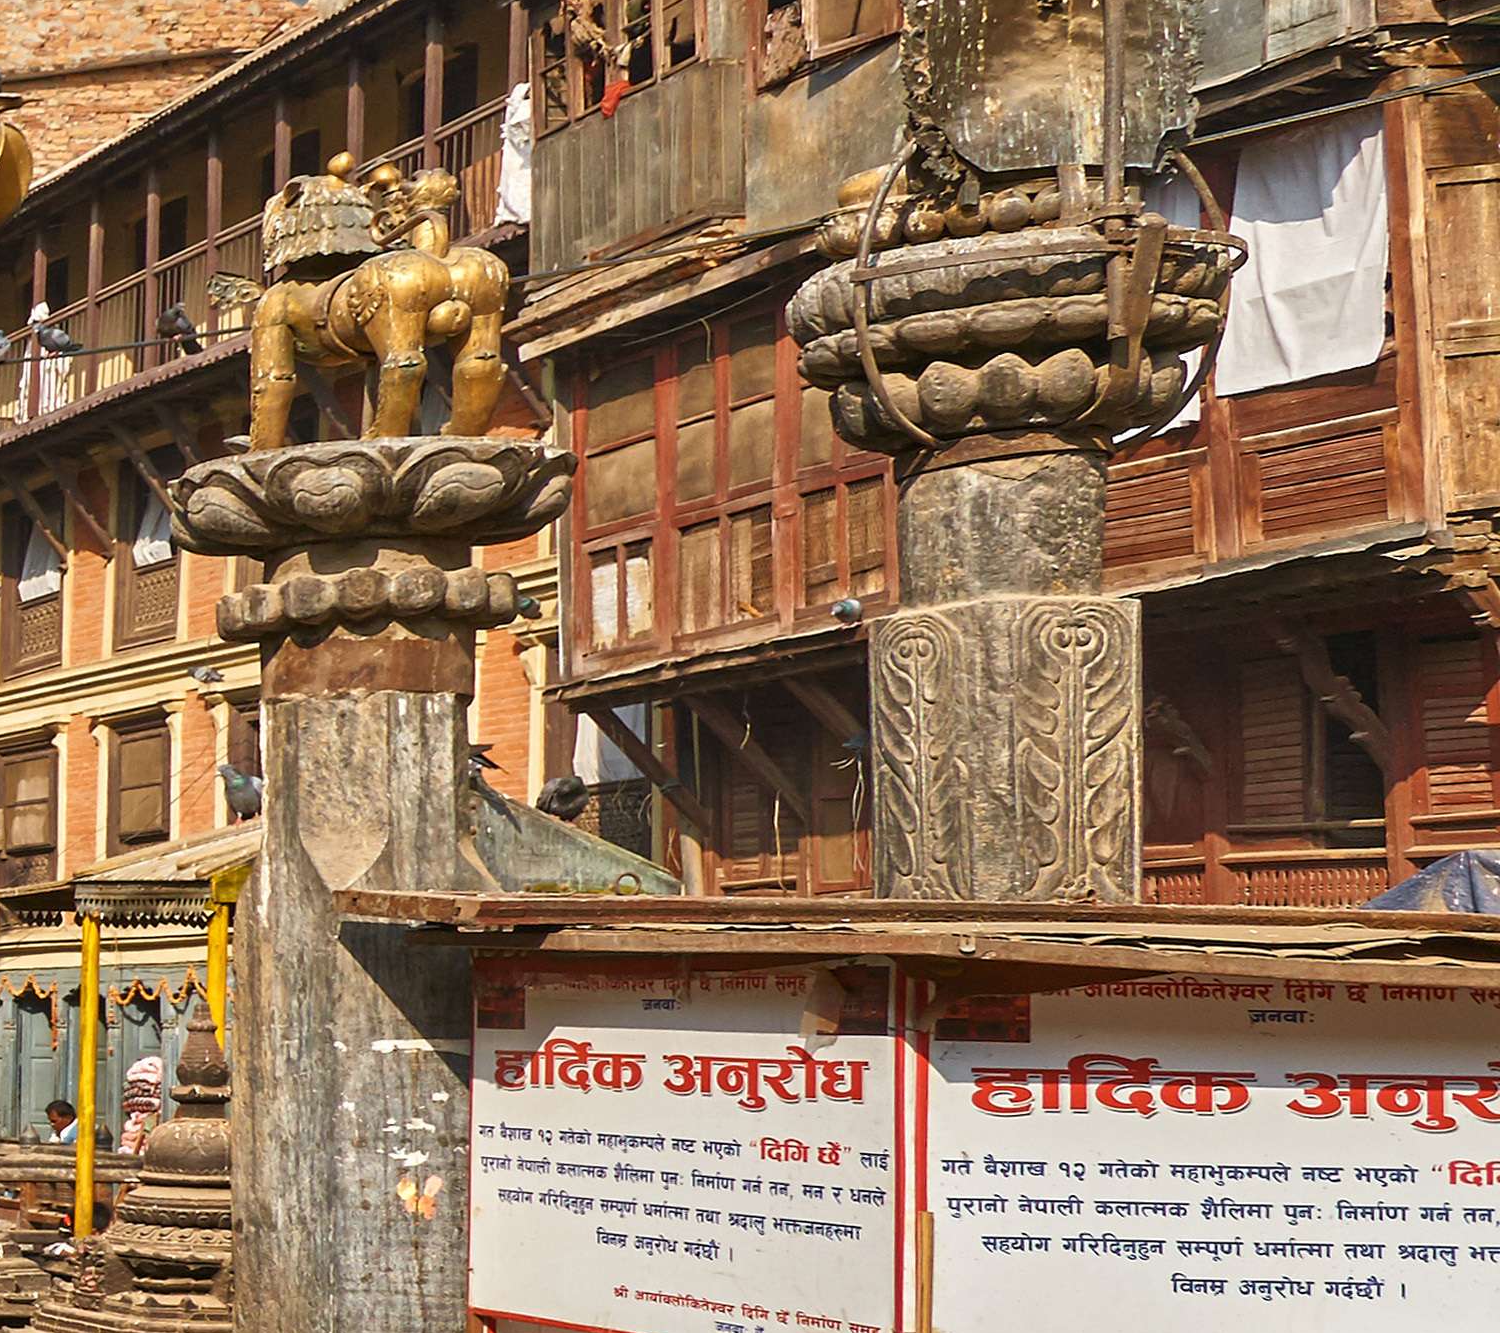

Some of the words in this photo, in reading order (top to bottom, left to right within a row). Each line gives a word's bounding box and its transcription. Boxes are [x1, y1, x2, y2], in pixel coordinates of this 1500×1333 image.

[495, 1038, 647, 1094] हार्दिक
[663, 1045, 870, 1112] अनुरोध
[972, 1054, 1258, 1119] हार्दिक
[479, 1125, 495, 1138] गत
[538, 1129, 552, 1145] १२
[703, 1139, 742, 1159] भएको
[860, 1149, 890, 1171] लाई
[481, 1155, 512, 1173] पुरानो
[517, 1156, 551, 1174] नेपाली
[691, 1169, 736, 1191] निर्माण
[802, 1185, 825, 1199] मन
[831, 1187, 843, 1204] र
[850, 1187, 886, 1207] धनले
[1059, 1162, 1085, 1181] १२
[1098, 1159, 1160, 1178] गतेको
[1301, 1167, 1344, 1182] नष्ट
[1354, 1164, 1419, 1187] भएको
[946, 1194, 1009, 1224] पुरानो
[1018, 1195, 1084, 1216] नेपाली
[1094, 1201, 1190, 1218] कलात्मक
[1200, 1196, 1273, 1220] शैलिमा
[1335, 1200, 1409, 1221] निर्माण
[1419, 1202, 1452, 1222] गर्न
[981, 1233, 1052, 1254] सहयोग
[1062, 1233, 1166, 1260] गरिदिनुहुन
[1176, 1237, 1244, 1261] सम्पूर्ण
[1254, 1238, 1334, 1258] धर्मात्मा
[1344, 1244, 1386, 1259] तथा
[1171, 1273, 1228, 1296] विनम्र
[1239, 1276, 1315, 1301] अनुरोध
